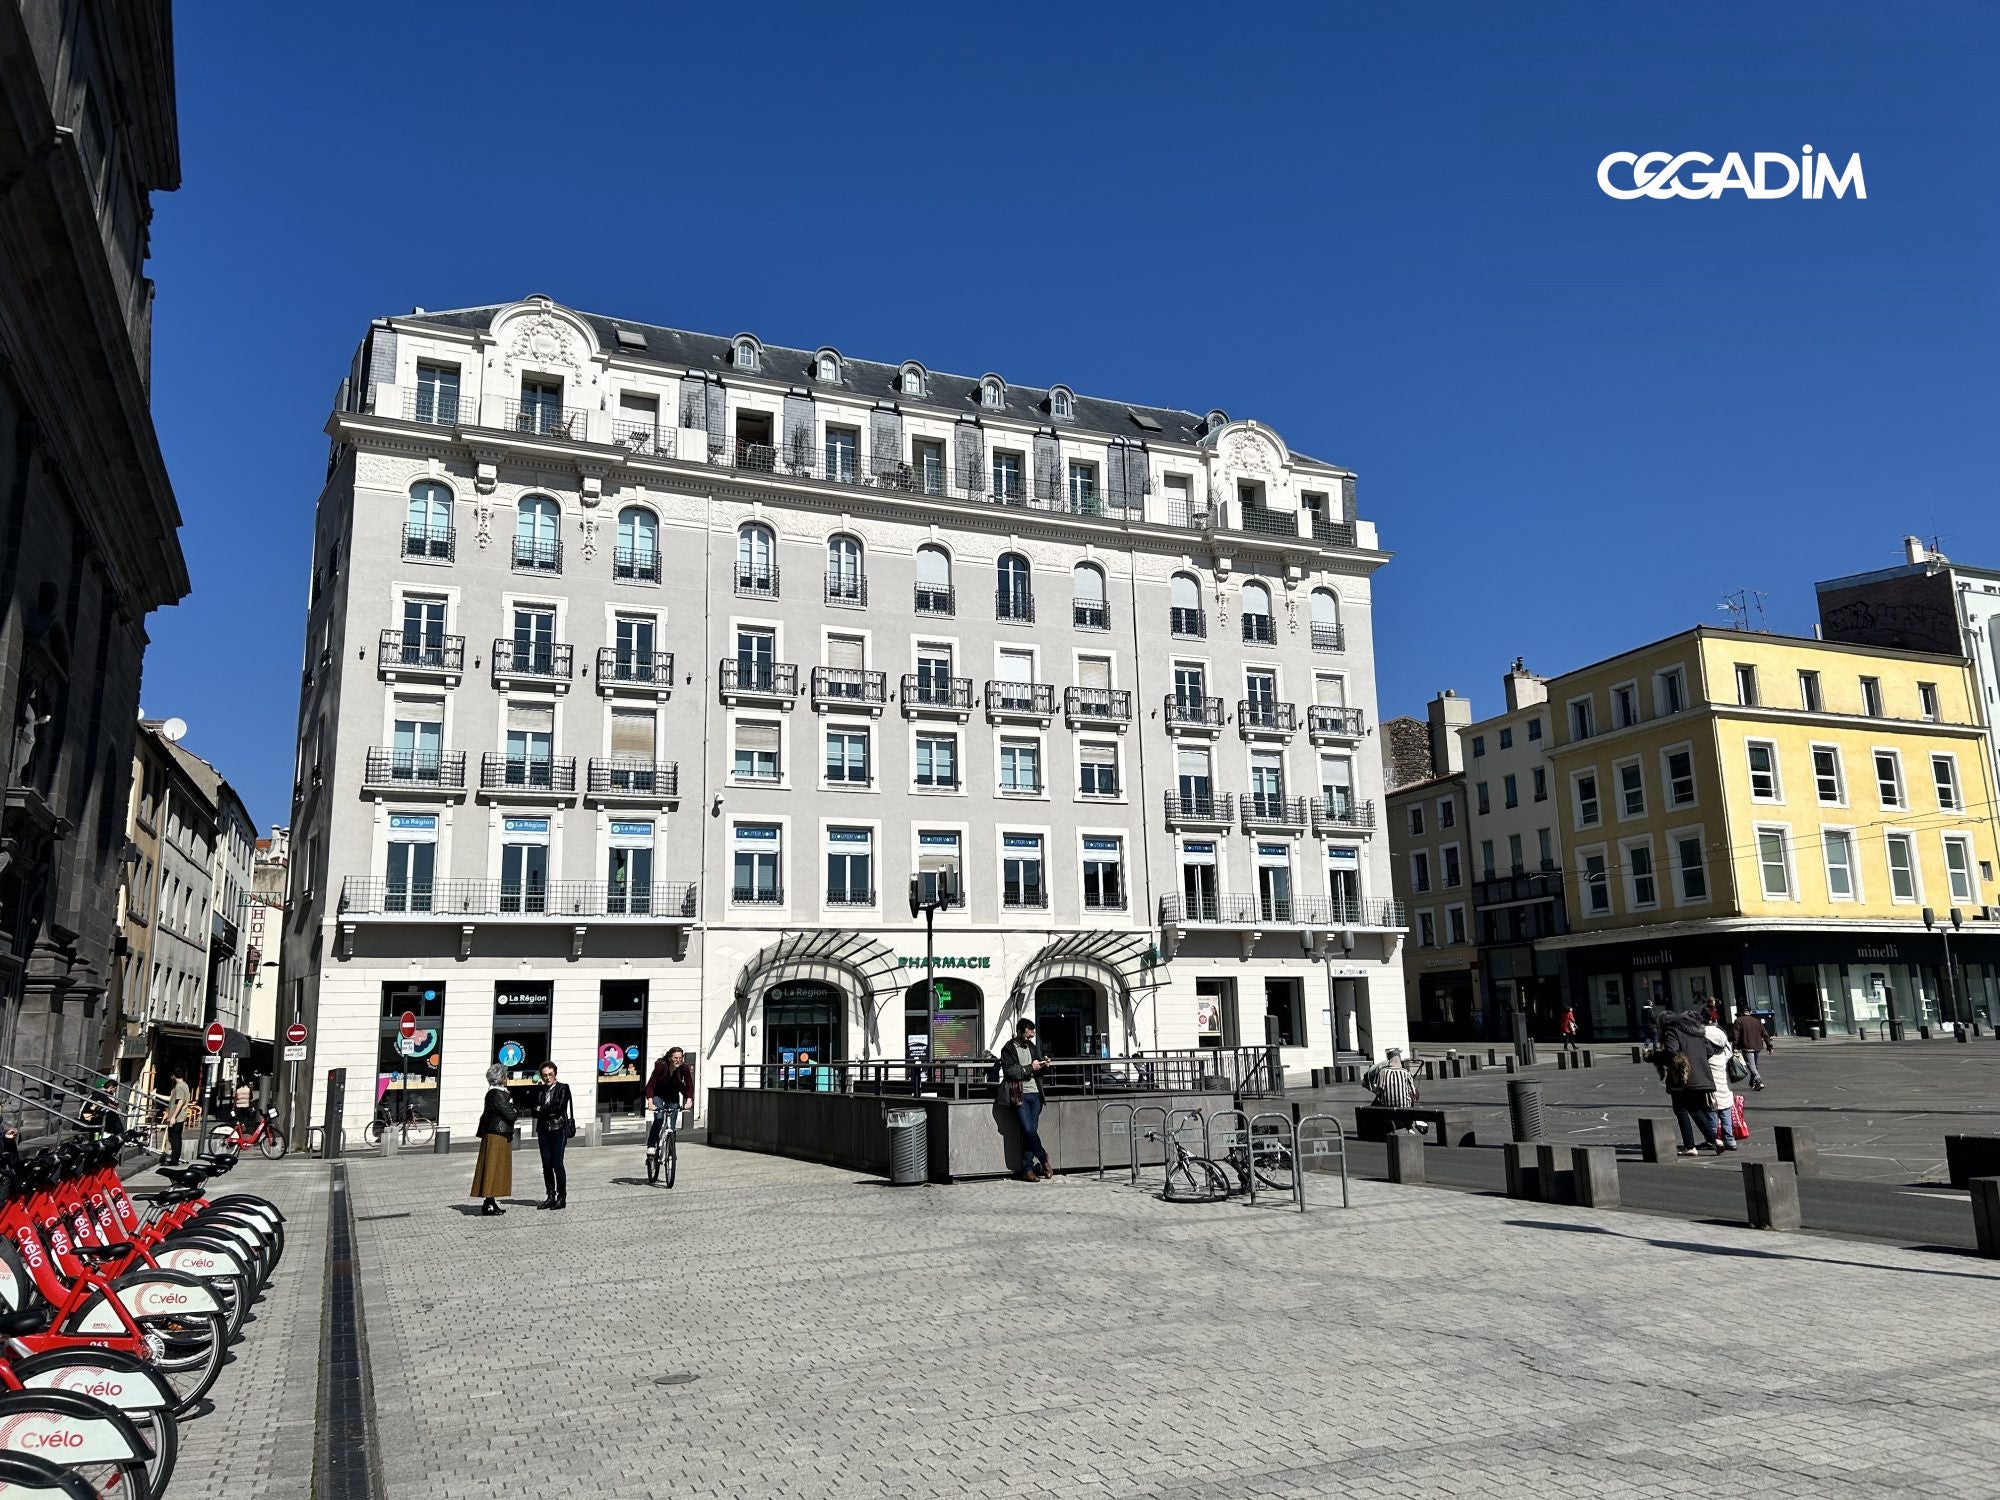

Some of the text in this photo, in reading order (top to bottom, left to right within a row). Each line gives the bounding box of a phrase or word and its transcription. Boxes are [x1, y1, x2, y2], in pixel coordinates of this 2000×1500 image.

[1632, 949, 1673, 965] minelli
[1857, 943, 1899, 958] minelli
[898, 956, 990, 969] PHARMACIE
[519, 993, 547, 1003] Région
[784, 987, 828, 998] La Région
[17, 1226, 43, 1268] C.vélo
[181, 1257, 214, 1269] C.vélo
[149, 1292, 188, 1305] C.vélo
[70, 1381, 123, 1396] Cvélo
[21, 1430, 84, 1449] C.vélo
